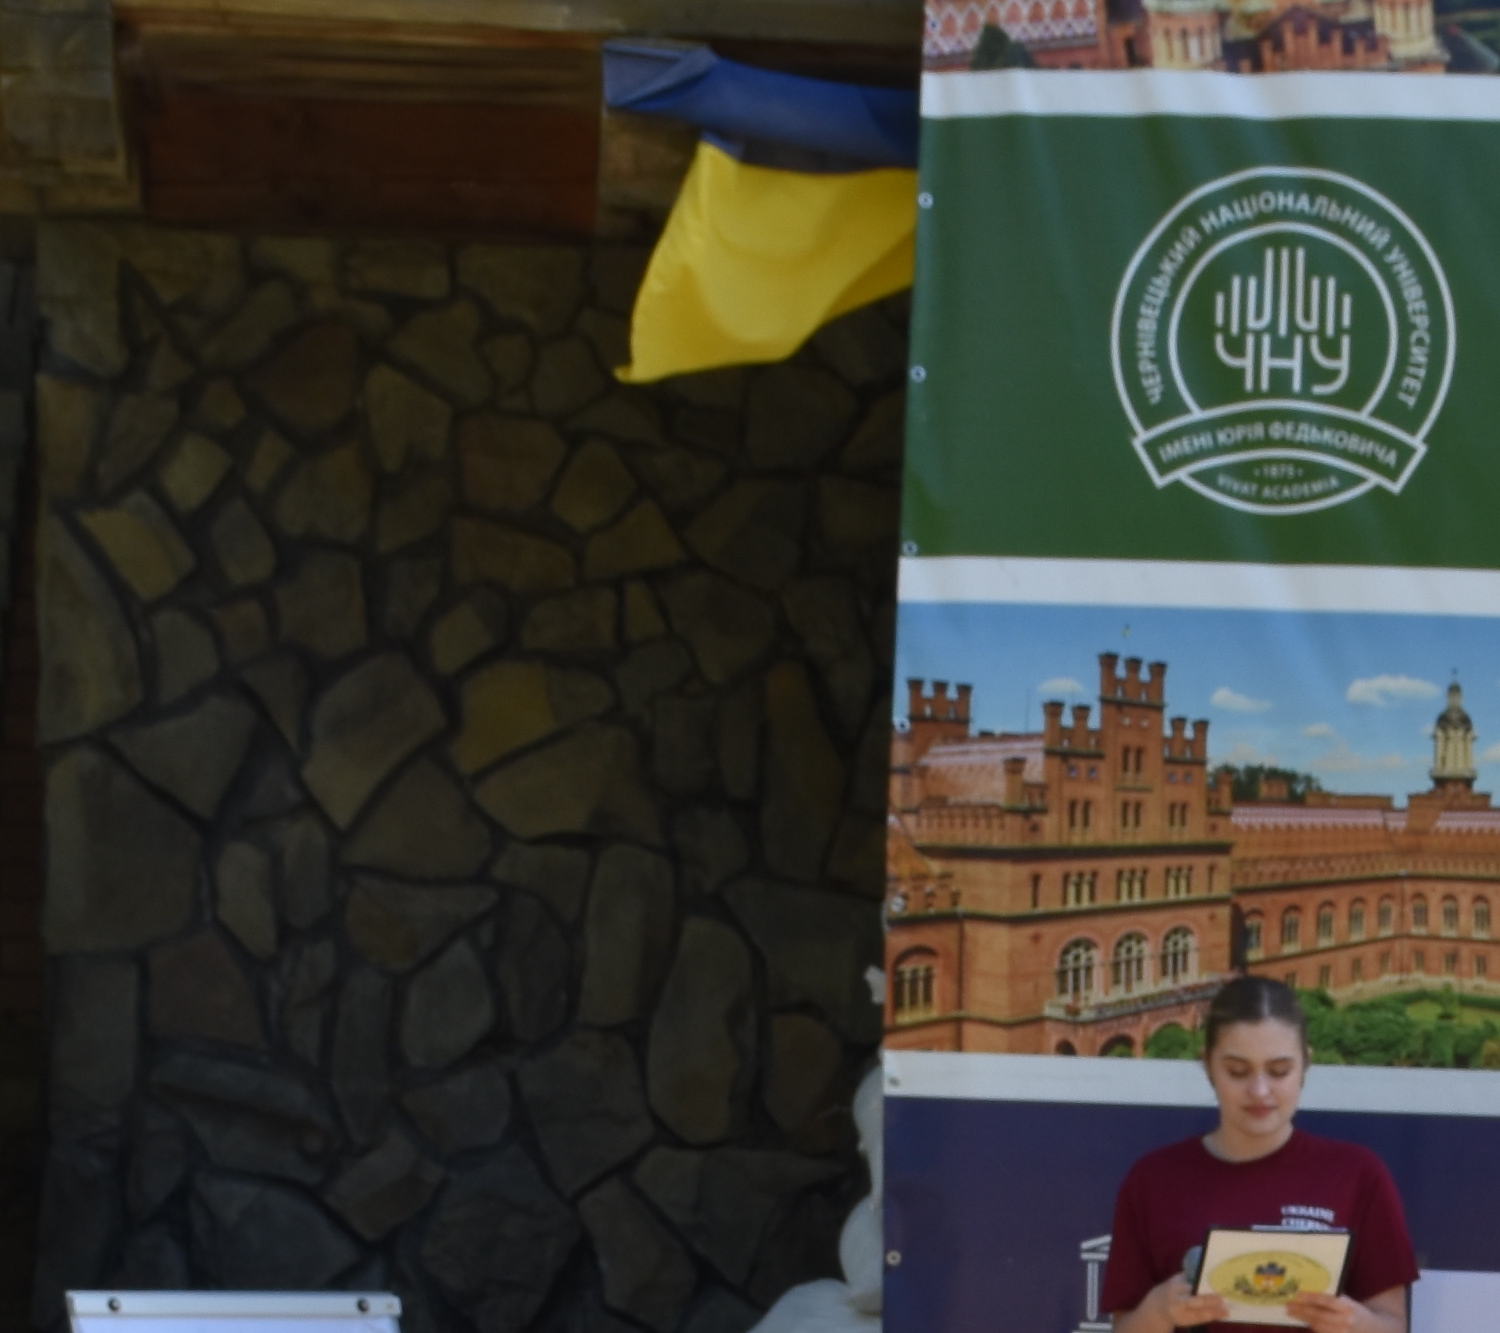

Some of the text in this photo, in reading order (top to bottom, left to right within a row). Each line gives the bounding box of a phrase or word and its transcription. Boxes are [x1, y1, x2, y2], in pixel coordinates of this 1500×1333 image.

[1200, 191, 1391, 249] НАЦІОНАЛЬНИЙ
[1383, 244, 1430, 409] УНІВЕРСИТЕТ
[1268, 421, 1397, 468] ФЕДЬКОВИЧА
